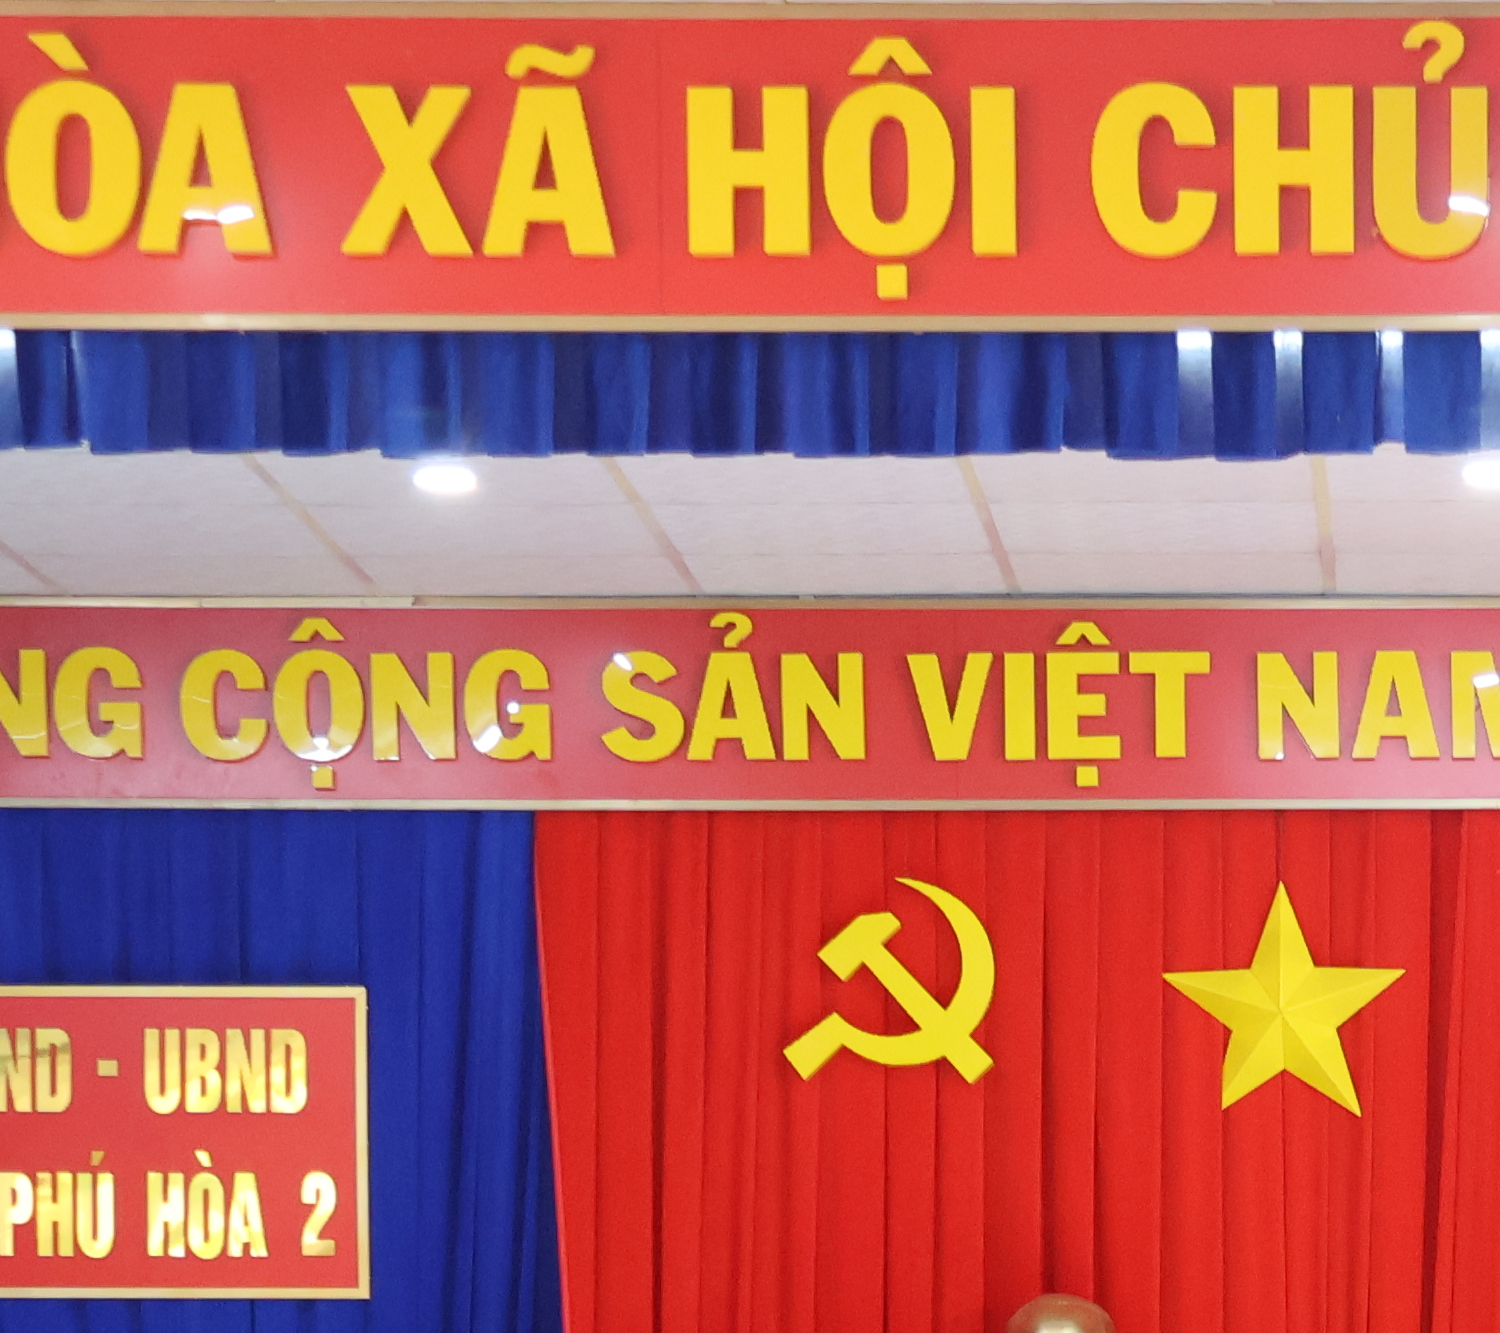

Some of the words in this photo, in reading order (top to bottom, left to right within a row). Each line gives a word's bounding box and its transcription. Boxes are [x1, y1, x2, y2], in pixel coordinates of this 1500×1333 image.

[341, 45, 614, 255] XÃ
[687, 37, 1016, 298] HỘI
[1091, 20, 1489, 257] CHỦ
[179, 617, 551, 788] CỘNG
[601, 612, 865, 761] SẢN
[907, 622, 1210, 786] VIỆT
[97, 1060, 118, 1076] -
[144, 1028, 308, 1114] UBND
[147, 1150, 268, 1259] HÒA
[300, 1171, 337, 1256] 2
